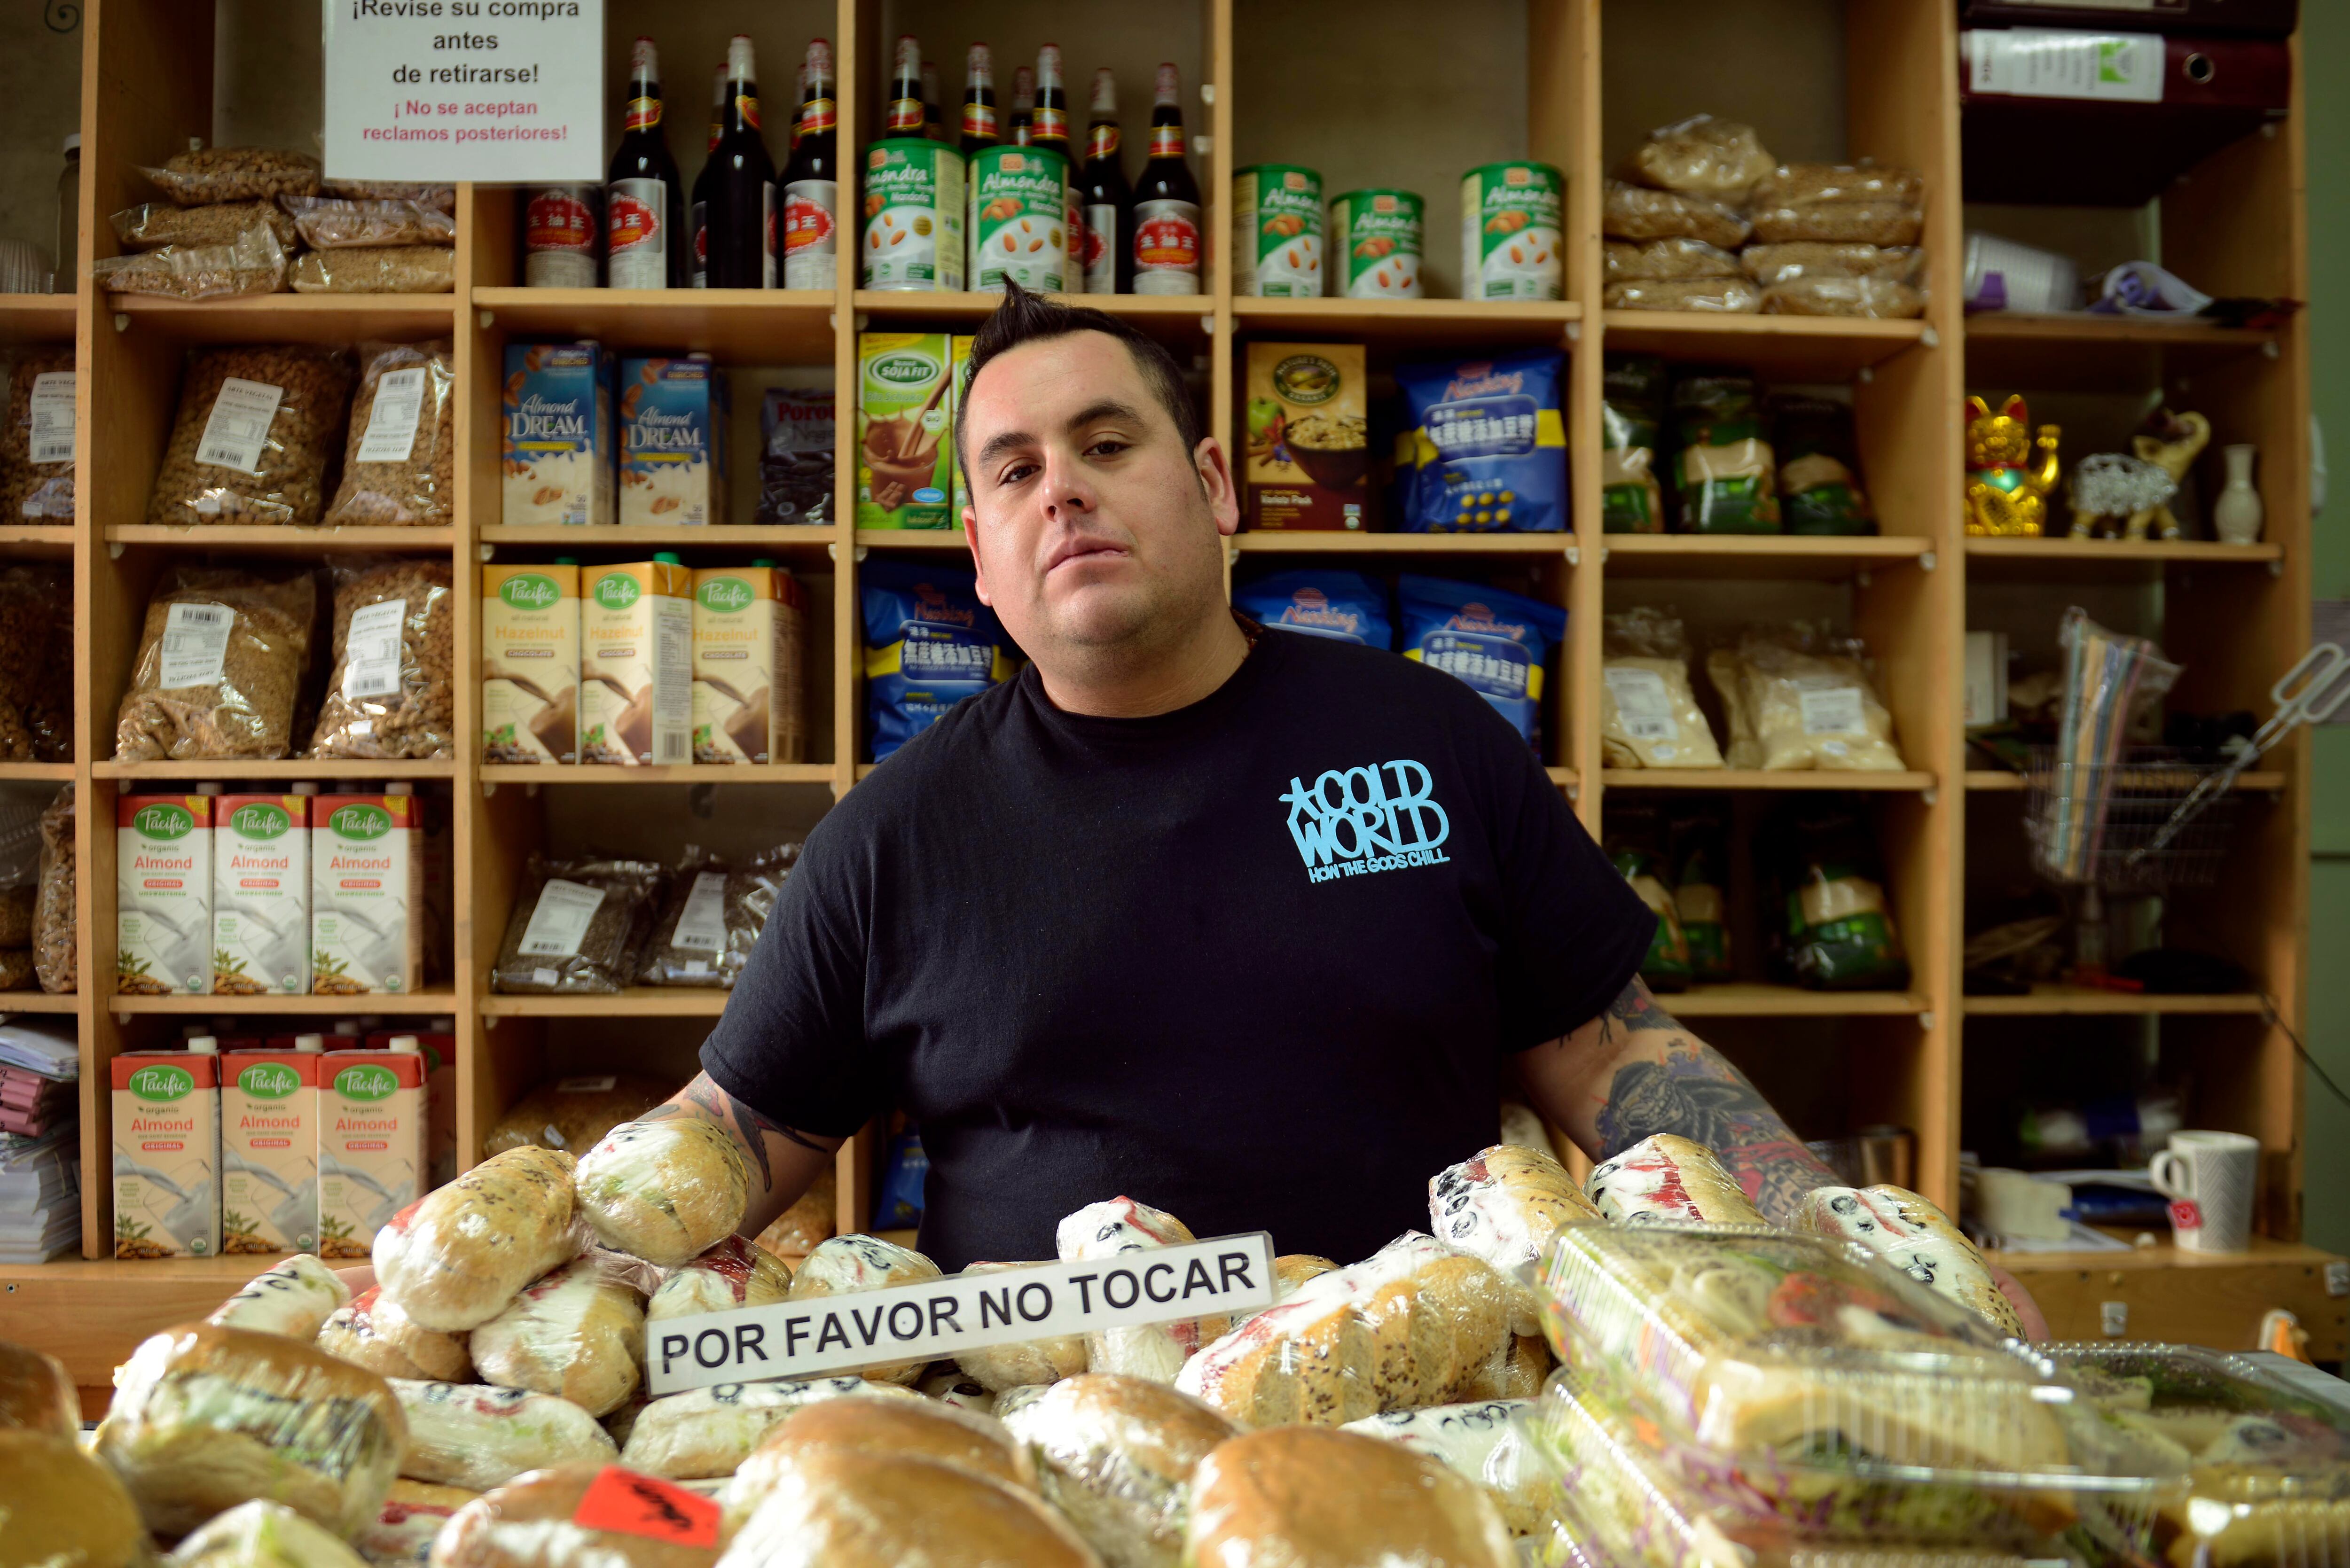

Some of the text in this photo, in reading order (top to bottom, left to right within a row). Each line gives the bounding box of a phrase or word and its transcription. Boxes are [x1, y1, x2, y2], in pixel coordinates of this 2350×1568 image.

[352, 0, 580, 20] ¡Revise su compra
[433, 31, 499, 49] antes
[392, 64, 540, 83] de retirarse!
[406, 100, 431, 115] No
[437, 103, 458, 115] se
[464, 102, 537, 118] aceptan
[363, 125, 568, 144] reclamos posteriores!
[521, 394, 579, 414] Almond
[638, 406, 694, 426] Almond
[511, 412, 586, 440] DREAM
[629, 424, 700, 450] DREAM
[506, 578, 554, 605] Pacific
[602, 578, 635, 603] Pacific
[702, 581, 749, 608] Pacific
[495, 625, 564, 640] Hazelnut
[590, 625, 644, 639] Hazelnut
[692, 628, 758, 642] Hazelnut
[1315, 759, 1433, 811] COLD
[140, 808, 188, 836] Pacific
[236, 809, 283, 835] Pacific
[336, 809, 384, 836] Pacific
[1287, 799, 1449, 868] WORLD
[149, 843, 179, 853] organic
[244, 843, 276, 853] organic
[345, 844, 376, 853] organic
[134, 856, 193, 869] Almond
[230, 855, 289, 869] Almond
[329, 856, 391, 870] Almond
[1308, 847, 1451, 883] HOW THE GODS CHILL
[136, 1070, 188, 1098] Pacific
[244, 1069, 294, 1096] Pacific
[339, 1070, 391, 1098] Pacific
[146, 1105, 180, 1116] organic
[254, 1102, 286, 1112] organic
[349, 1105, 383, 1115] organic
[131, 1117, 194, 1132] Almond
[240, 1116, 300, 1129] Almond
[335, 1117, 397, 1132] Almond
[661, 1251, 1256, 1375] POR FAVOR NO TOCAR
